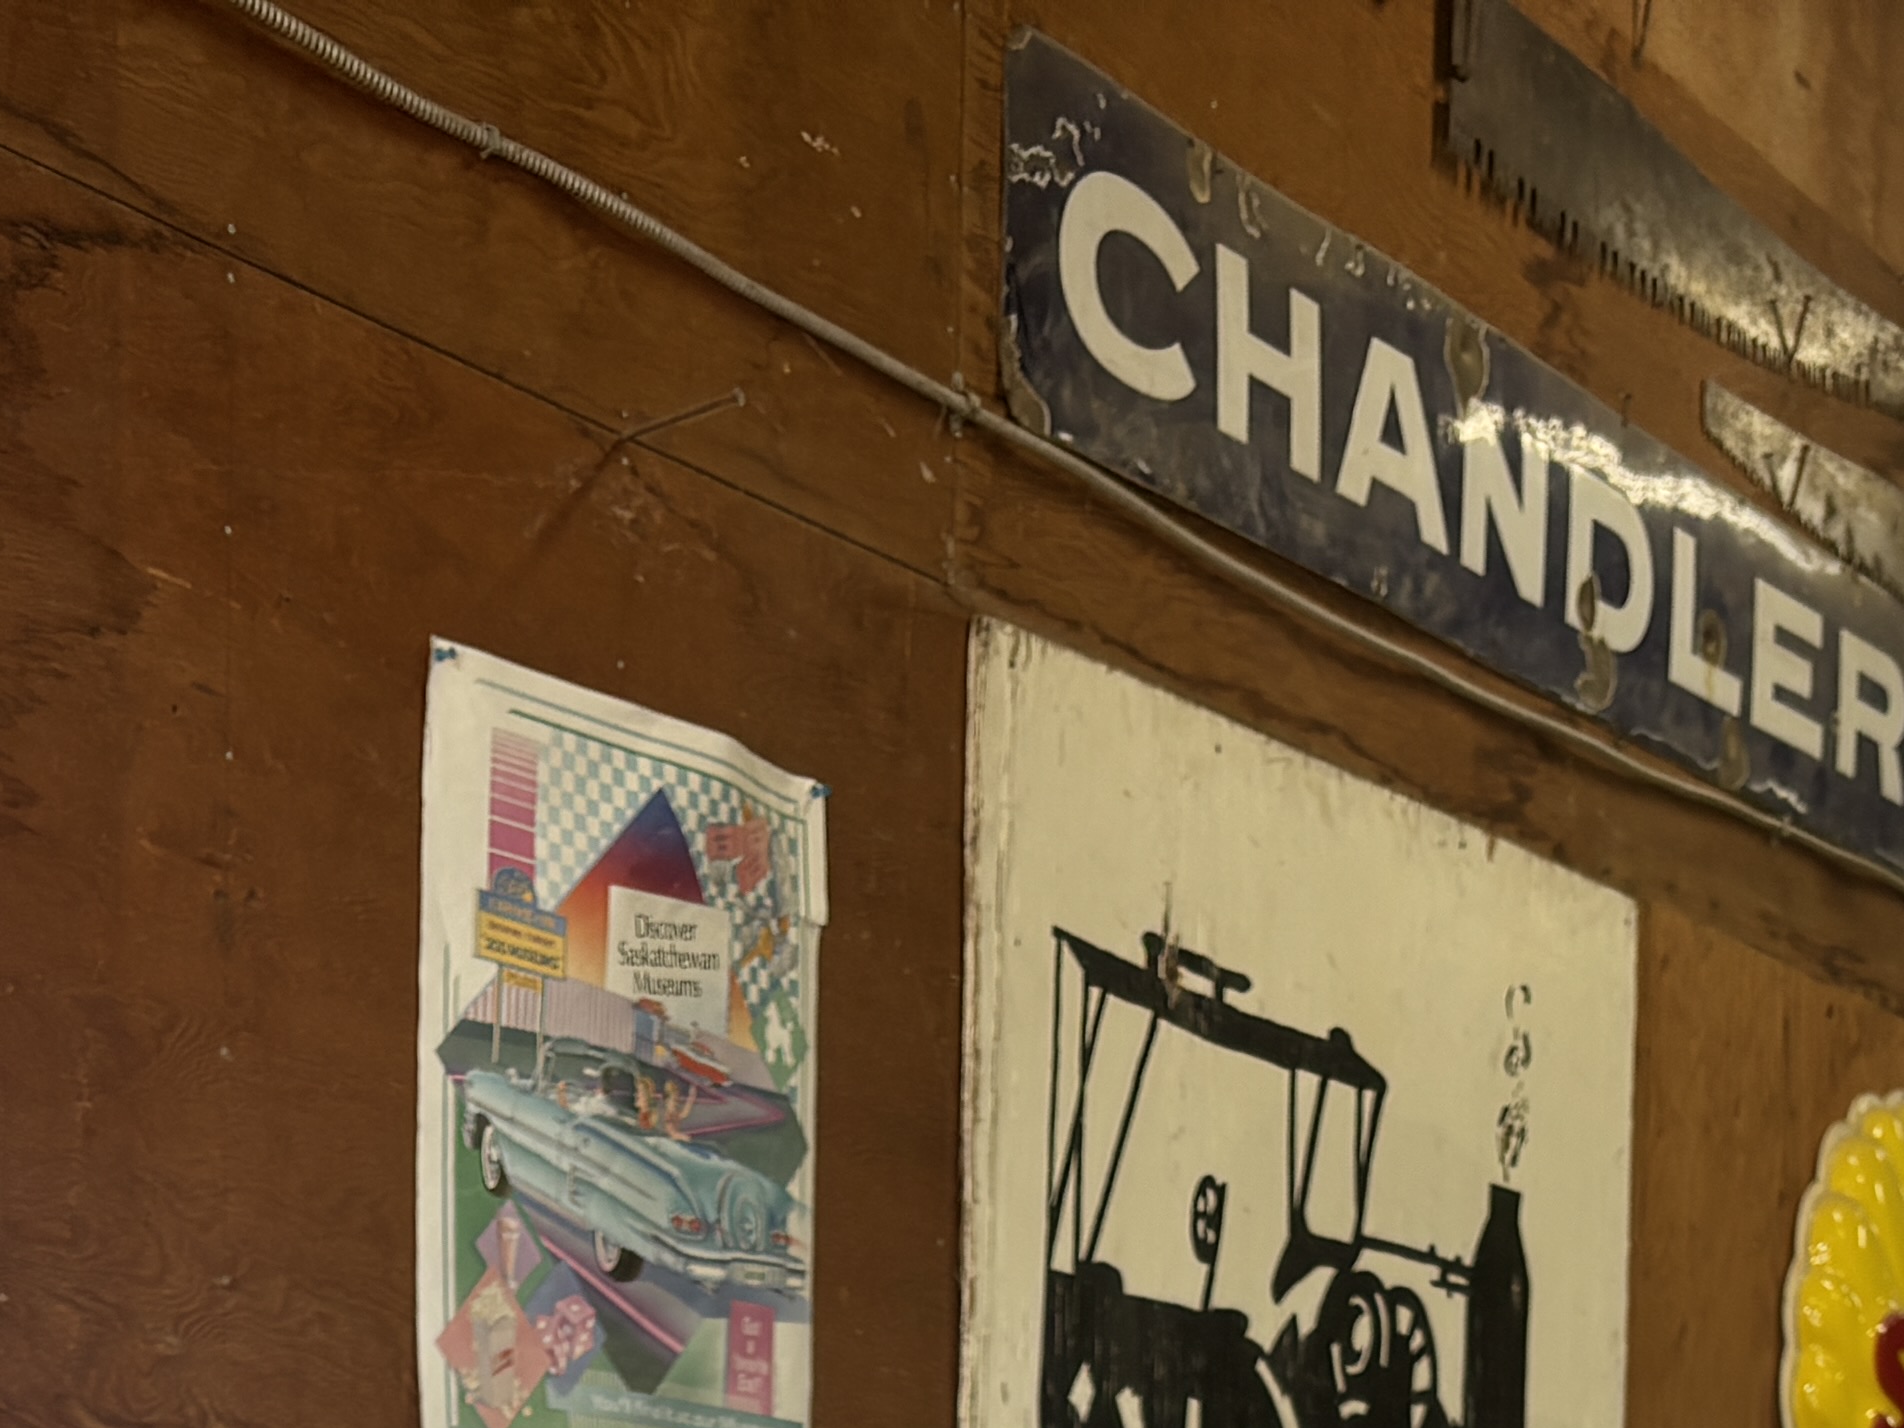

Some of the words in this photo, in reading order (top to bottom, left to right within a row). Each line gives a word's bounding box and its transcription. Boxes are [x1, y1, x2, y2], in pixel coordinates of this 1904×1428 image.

[634, 912, 698, 941] Discover
[617, 940, 720, 970] Saskatchewan
[633, 970, 703, 997] Museums
